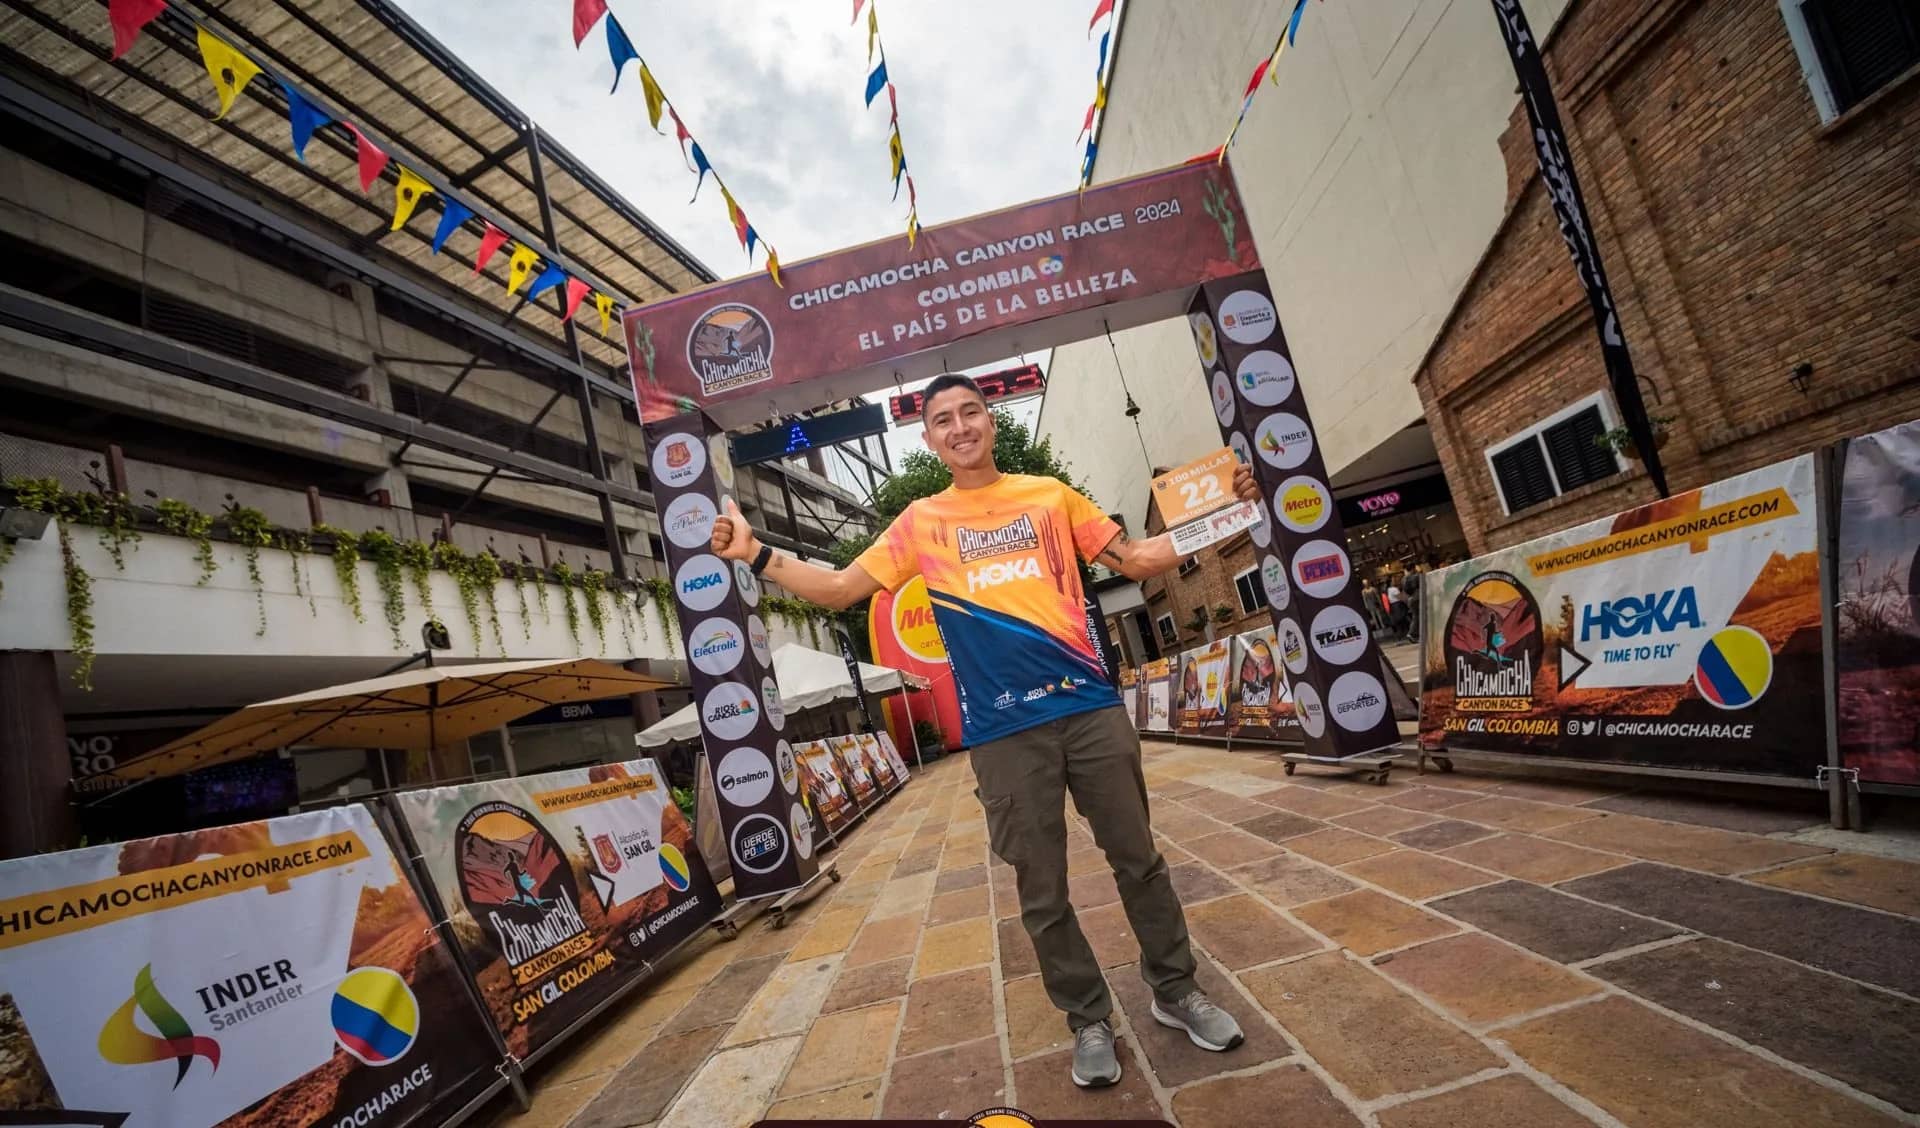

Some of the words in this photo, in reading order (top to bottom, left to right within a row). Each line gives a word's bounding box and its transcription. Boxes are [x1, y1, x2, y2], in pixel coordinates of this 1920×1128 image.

[789, 257, 949, 311] CHICAMOCHA
[955, 230, 1055, 266] CANYON
[1062, 213, 1125, 241] RACE
[1135, 198, 1181, 224] 2024
[918, 265, 1037, 307] COLOMBIA
[858, 331, 884, 351] EL
[893, 312, 947, 341] PAÍS
[956, 303, 987, 325] DE
[996, 294, 1027, 315] LA
[1036, 268, 1137, 305] BELLEZA
[702, 344, 767, 384] CHICAMOCHA
[712, 377, 742, 390] CANYON
[1281, 431, 1307, 442] INDER
[1179, 474, 1225, 510] 22
[1285, 497, 1322, 512] Metro
[957, 514, 1035, 553] CHICAMOCHA
[970, 547, 1006, 559] CANYON
[1008, 541, 1031, 551] RACE
[683, 572, 722, 593] HOKA
[967, 557, 1043, 594] HOKA
[1581, 586, 1702, 642] HOKA
[694, 640, 737, 658] Electrolit
[1603, 648, 1631, 663] TIME
[1634, 646, 1650, 660] TO
[1456, 650, 1531, 697] CHICAMOCHA
[561, 704, 593, 718] BBVA
[1463, 700, 1498, 709] CANYON
[1500, 699, 1523, 709] RACE
[1443, 718, 1467, 731] SAN
[1468, 719, 1486, 732] GIL
[1487, 719, 1558, 735] COLOMBIA
[1605, 722, 1753, 739] @CHICAMOCHARACE
[735, 770, 769, 786] salmón
[624, 843, 642, 860] SAN
[641, 839, 655, 853] GIL
[489, 885, 586, 966] CHICAMOCHA
[523, 946, 566, 979] CANYON
[196, 959, 298, 1014] INDER
[513, 990, 545, 1023] SAN
[541, 983, 563, 1004] GIL
[559, 949, 616, 993] COLOMBIA
[209, 982, 304, 1032] Santander
